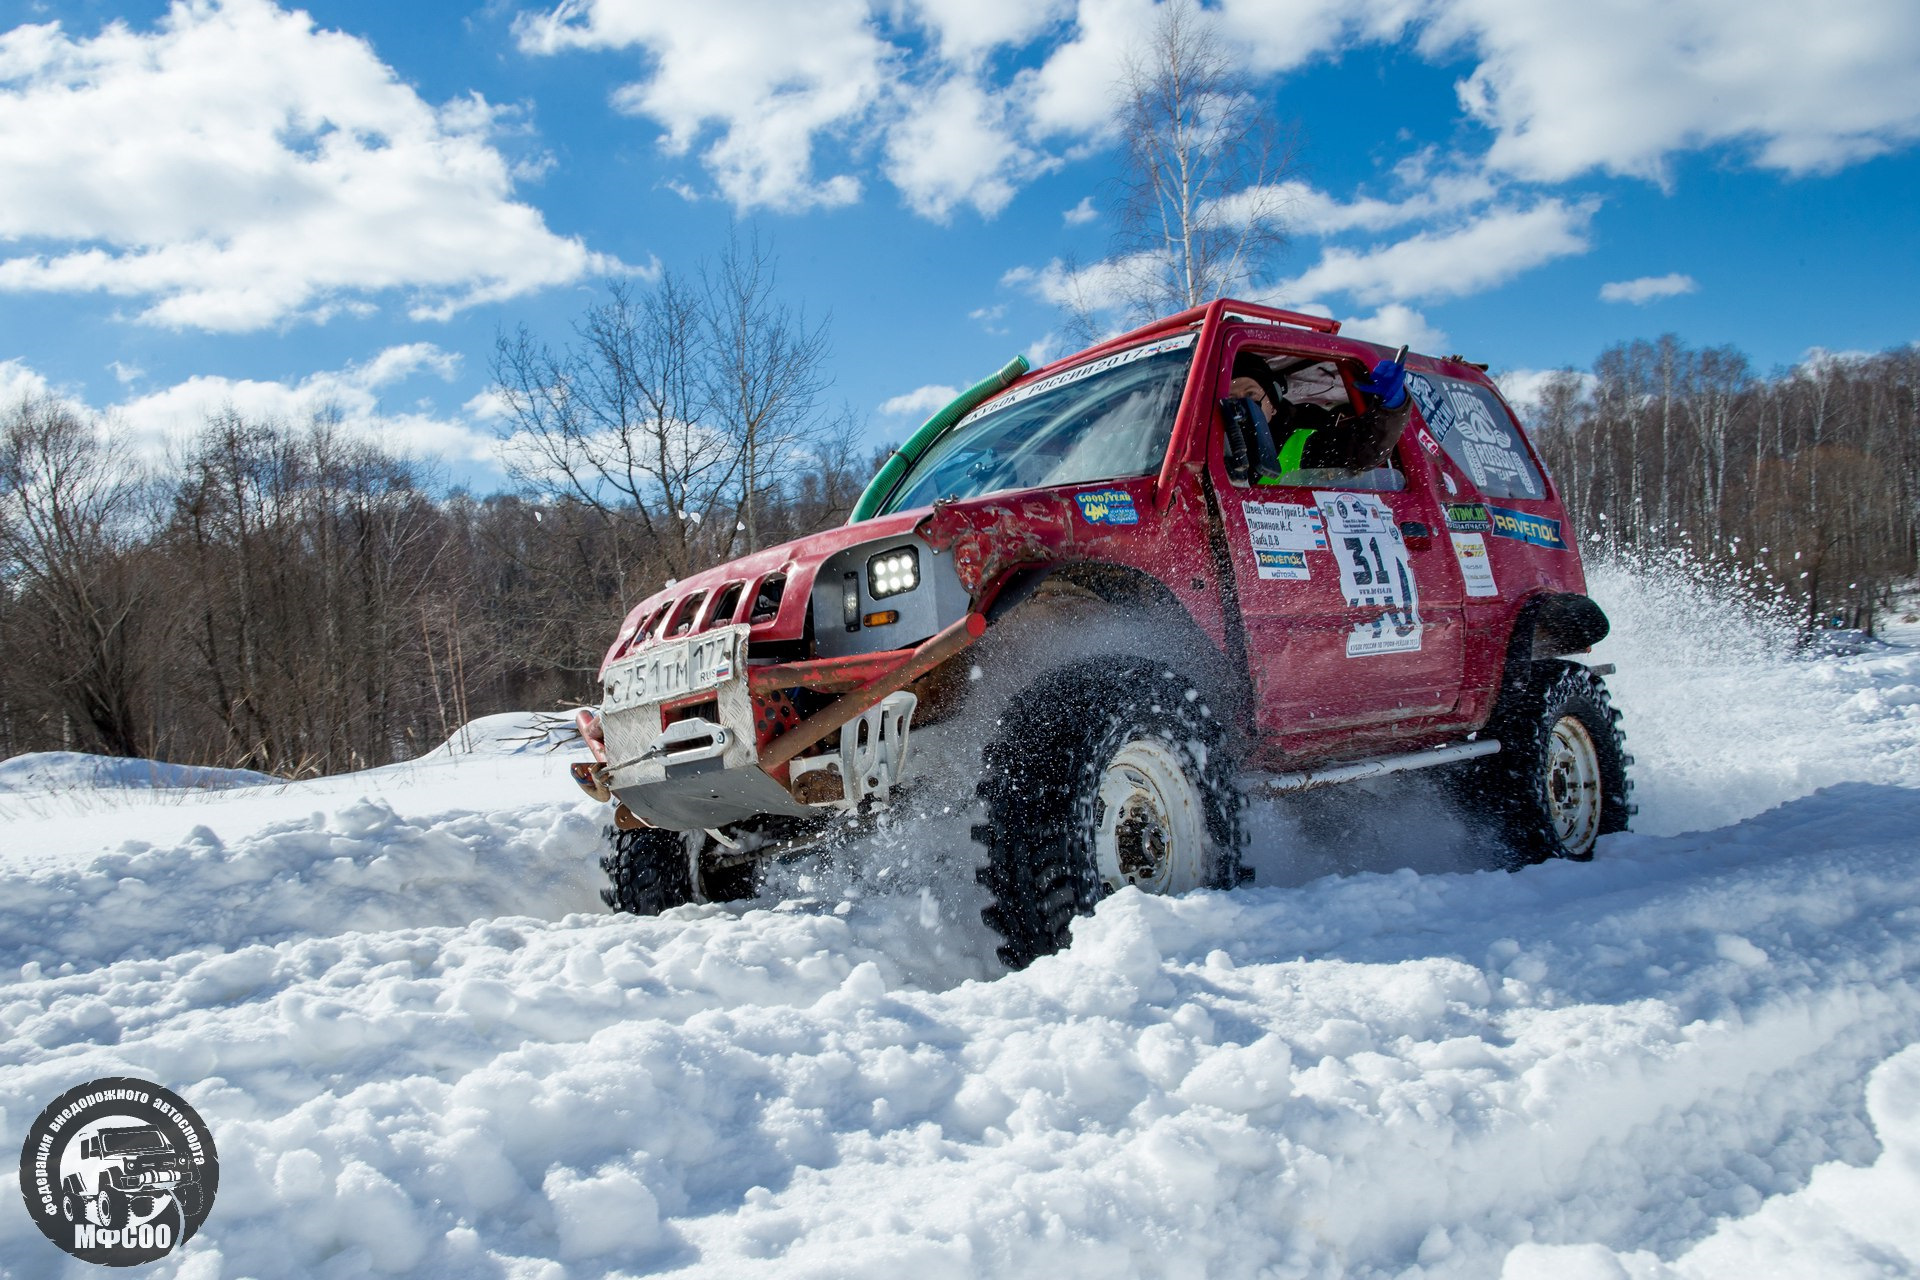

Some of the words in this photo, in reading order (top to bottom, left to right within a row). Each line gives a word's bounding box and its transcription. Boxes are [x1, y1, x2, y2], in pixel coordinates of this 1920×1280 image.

[1494, 515, 1560, 542] RAVENOL
[1343, 537, 1390, 585] 31
[700, 668, 716, 681] RUS
